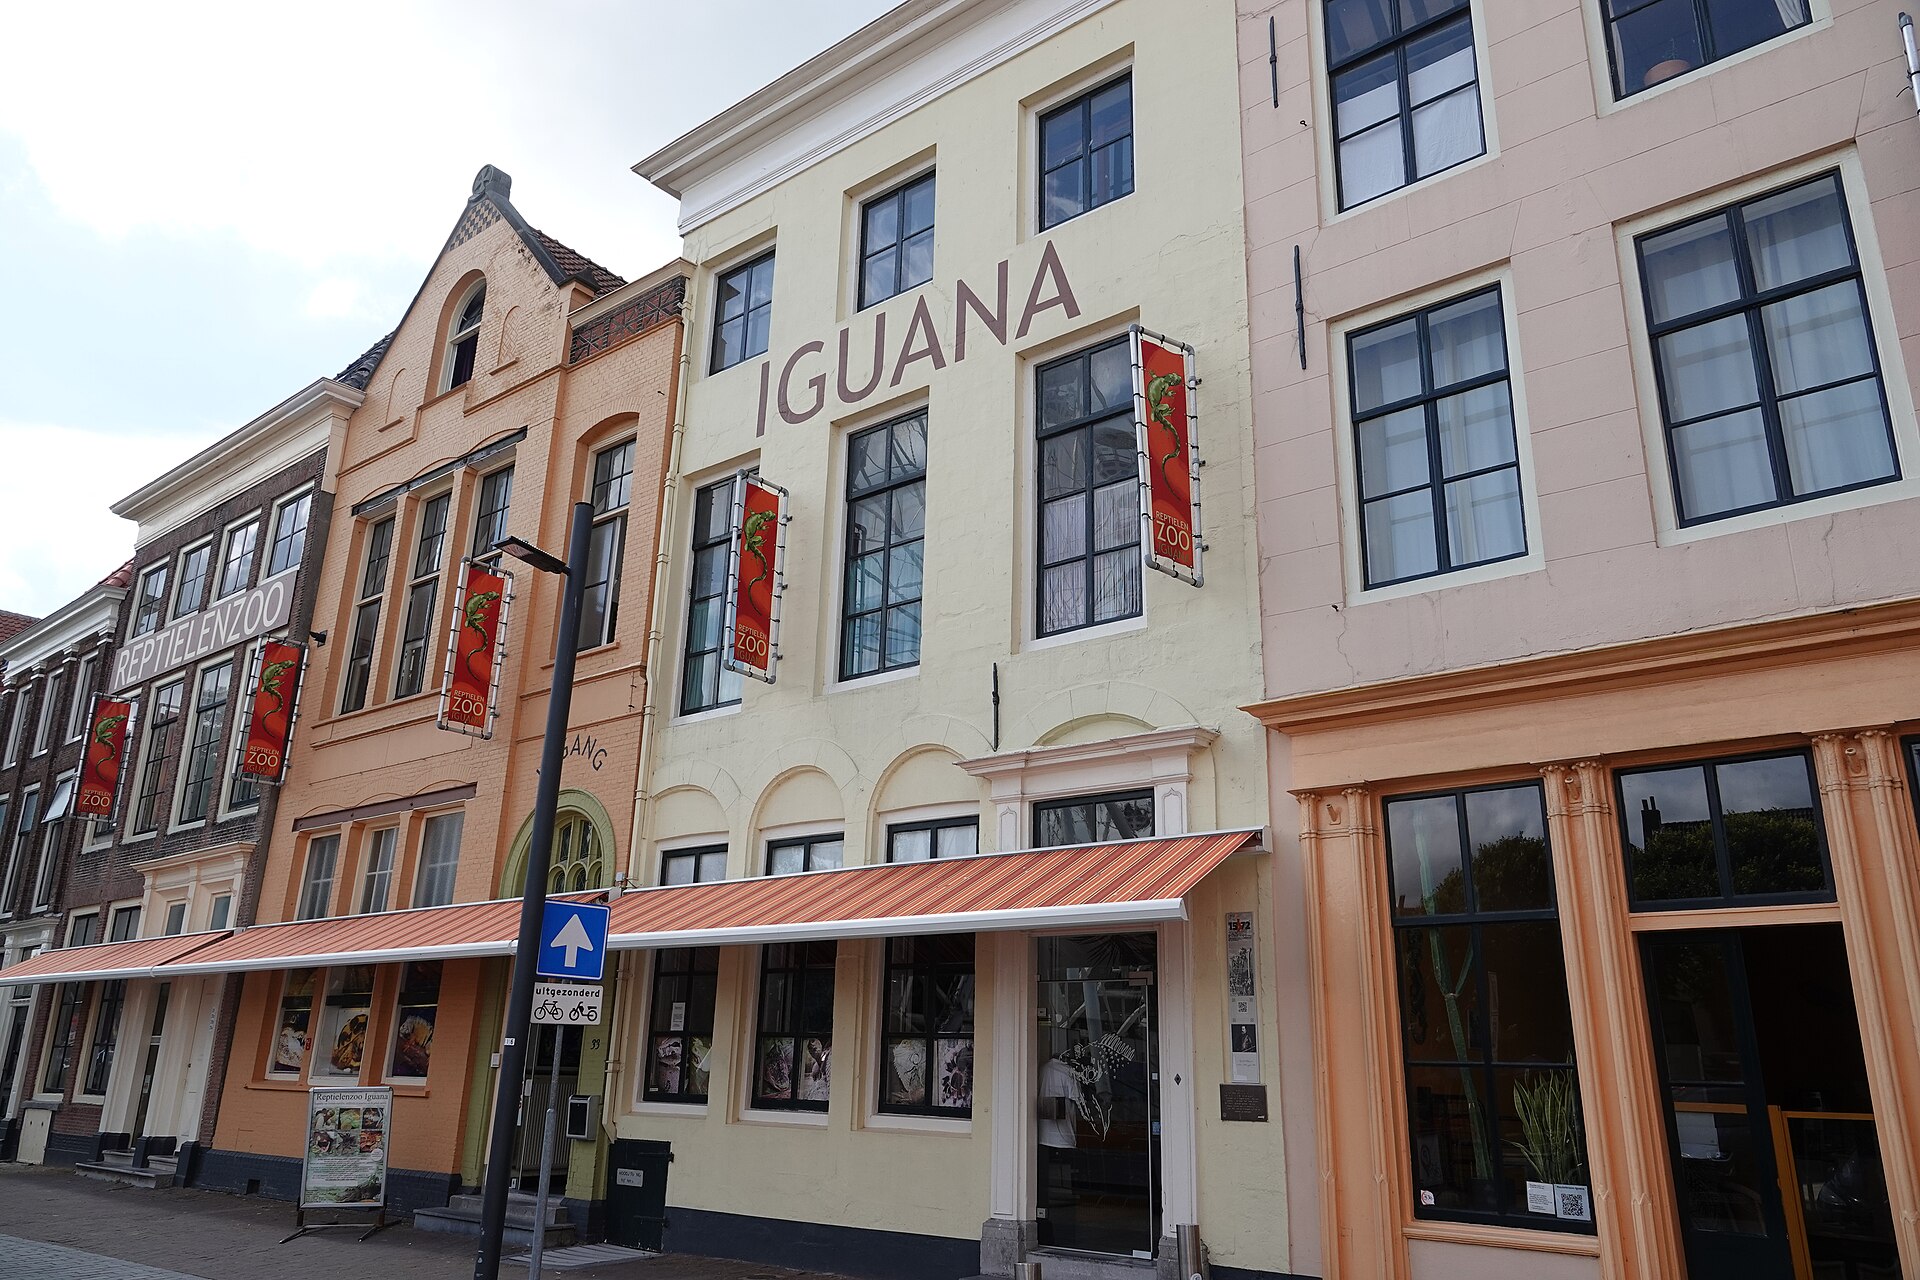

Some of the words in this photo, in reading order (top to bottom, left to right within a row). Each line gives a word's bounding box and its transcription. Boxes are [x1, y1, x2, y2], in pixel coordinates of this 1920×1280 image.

[756, 240, 1081, 438] IGUANA
[1155, 510, 1189, 531] REPTIELEN
[1156, 520, 1190, 551] ZOO
[1157, 542, 1189, 562] IGUANA
[114, 581, 284, 690] REPTIELENZOO
[738, 624, 767, 640] REPTIELEN
[737, 632, 767, 656] ZOO
[453, 690, 485, 702] REPTIELEN
[452, 696, 484, 716] ZOO
[451, 711, 481, 724] IGUANA
[250, 746, 280, 755] REPTIELEN
[247, 751, 278, 767] ZOO
[82, 794, 110, 807] ZOO
[84, 789, 111, 797] REPTIELEN
[536, 986, 600, 998] uitgezonderd
[316, 1092, 363, 1102] Reptielenzoo
[365, 1092, 389, 1102] Iguana
